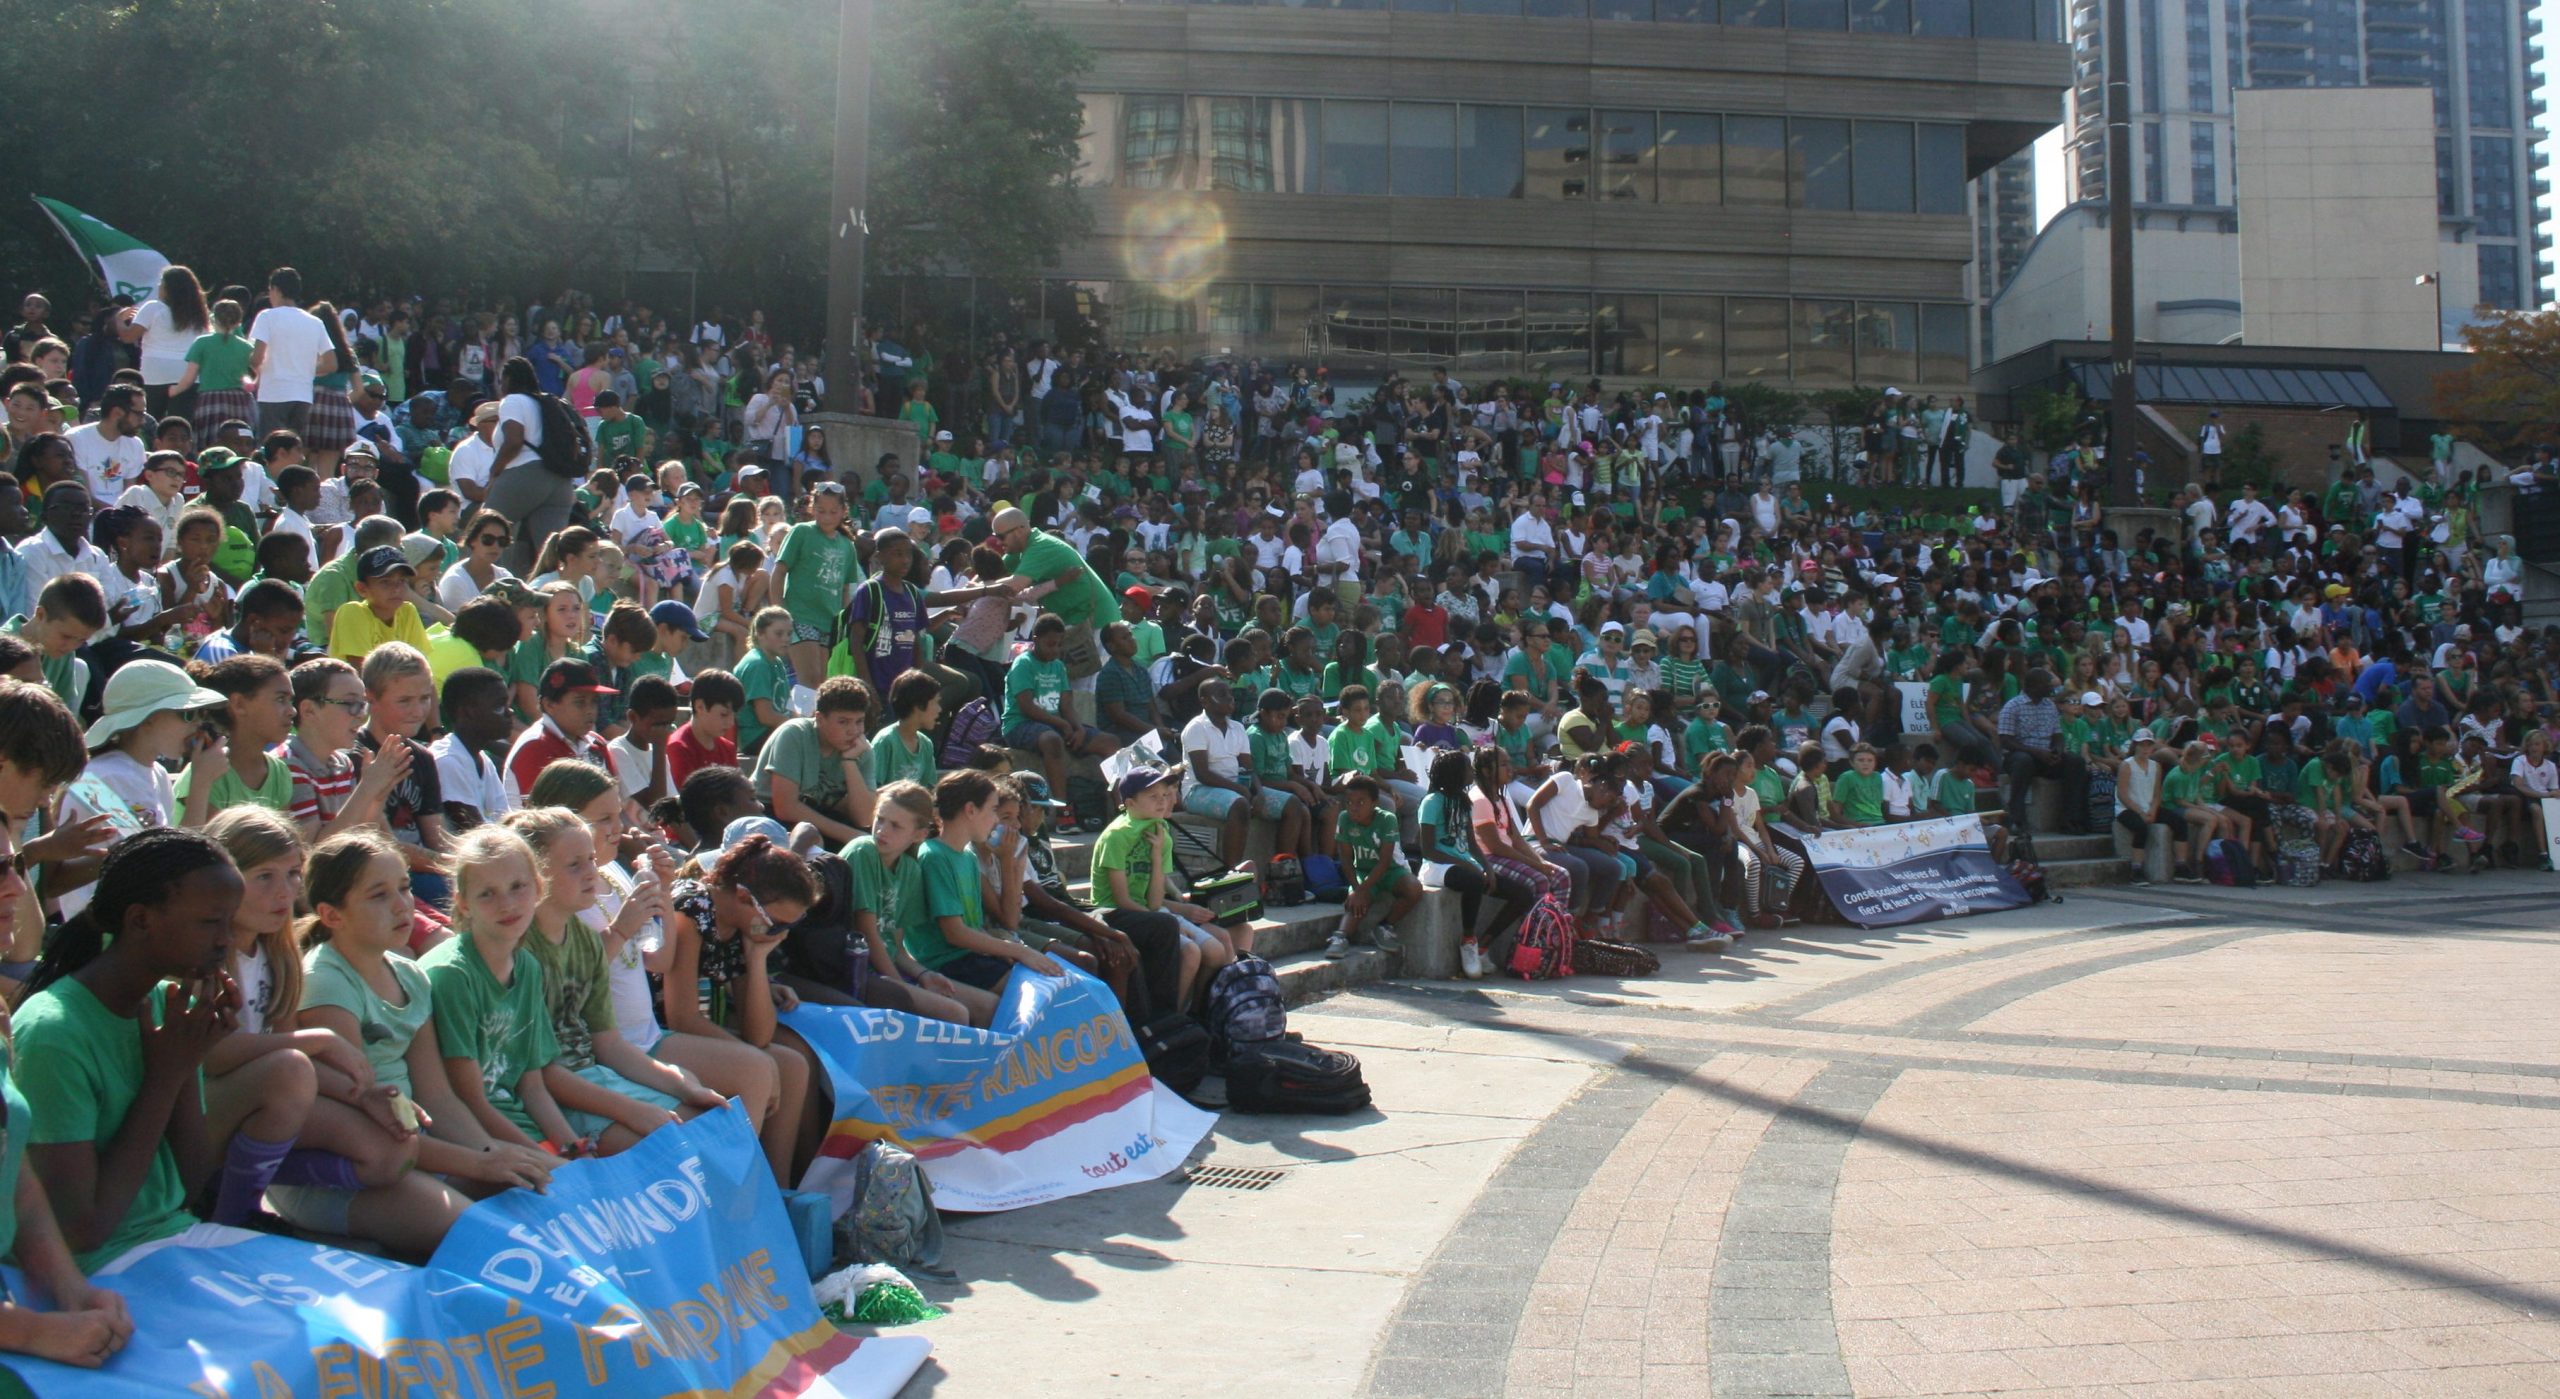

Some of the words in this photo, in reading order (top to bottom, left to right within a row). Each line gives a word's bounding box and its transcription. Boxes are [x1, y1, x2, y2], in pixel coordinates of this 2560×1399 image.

[1857, 904, 1882, 916] fiers
[842, 1008, 905, 1045] LES
[1081, 1152, 1128, 1178] tout
[1125, 1132, 1154, 1160] est
